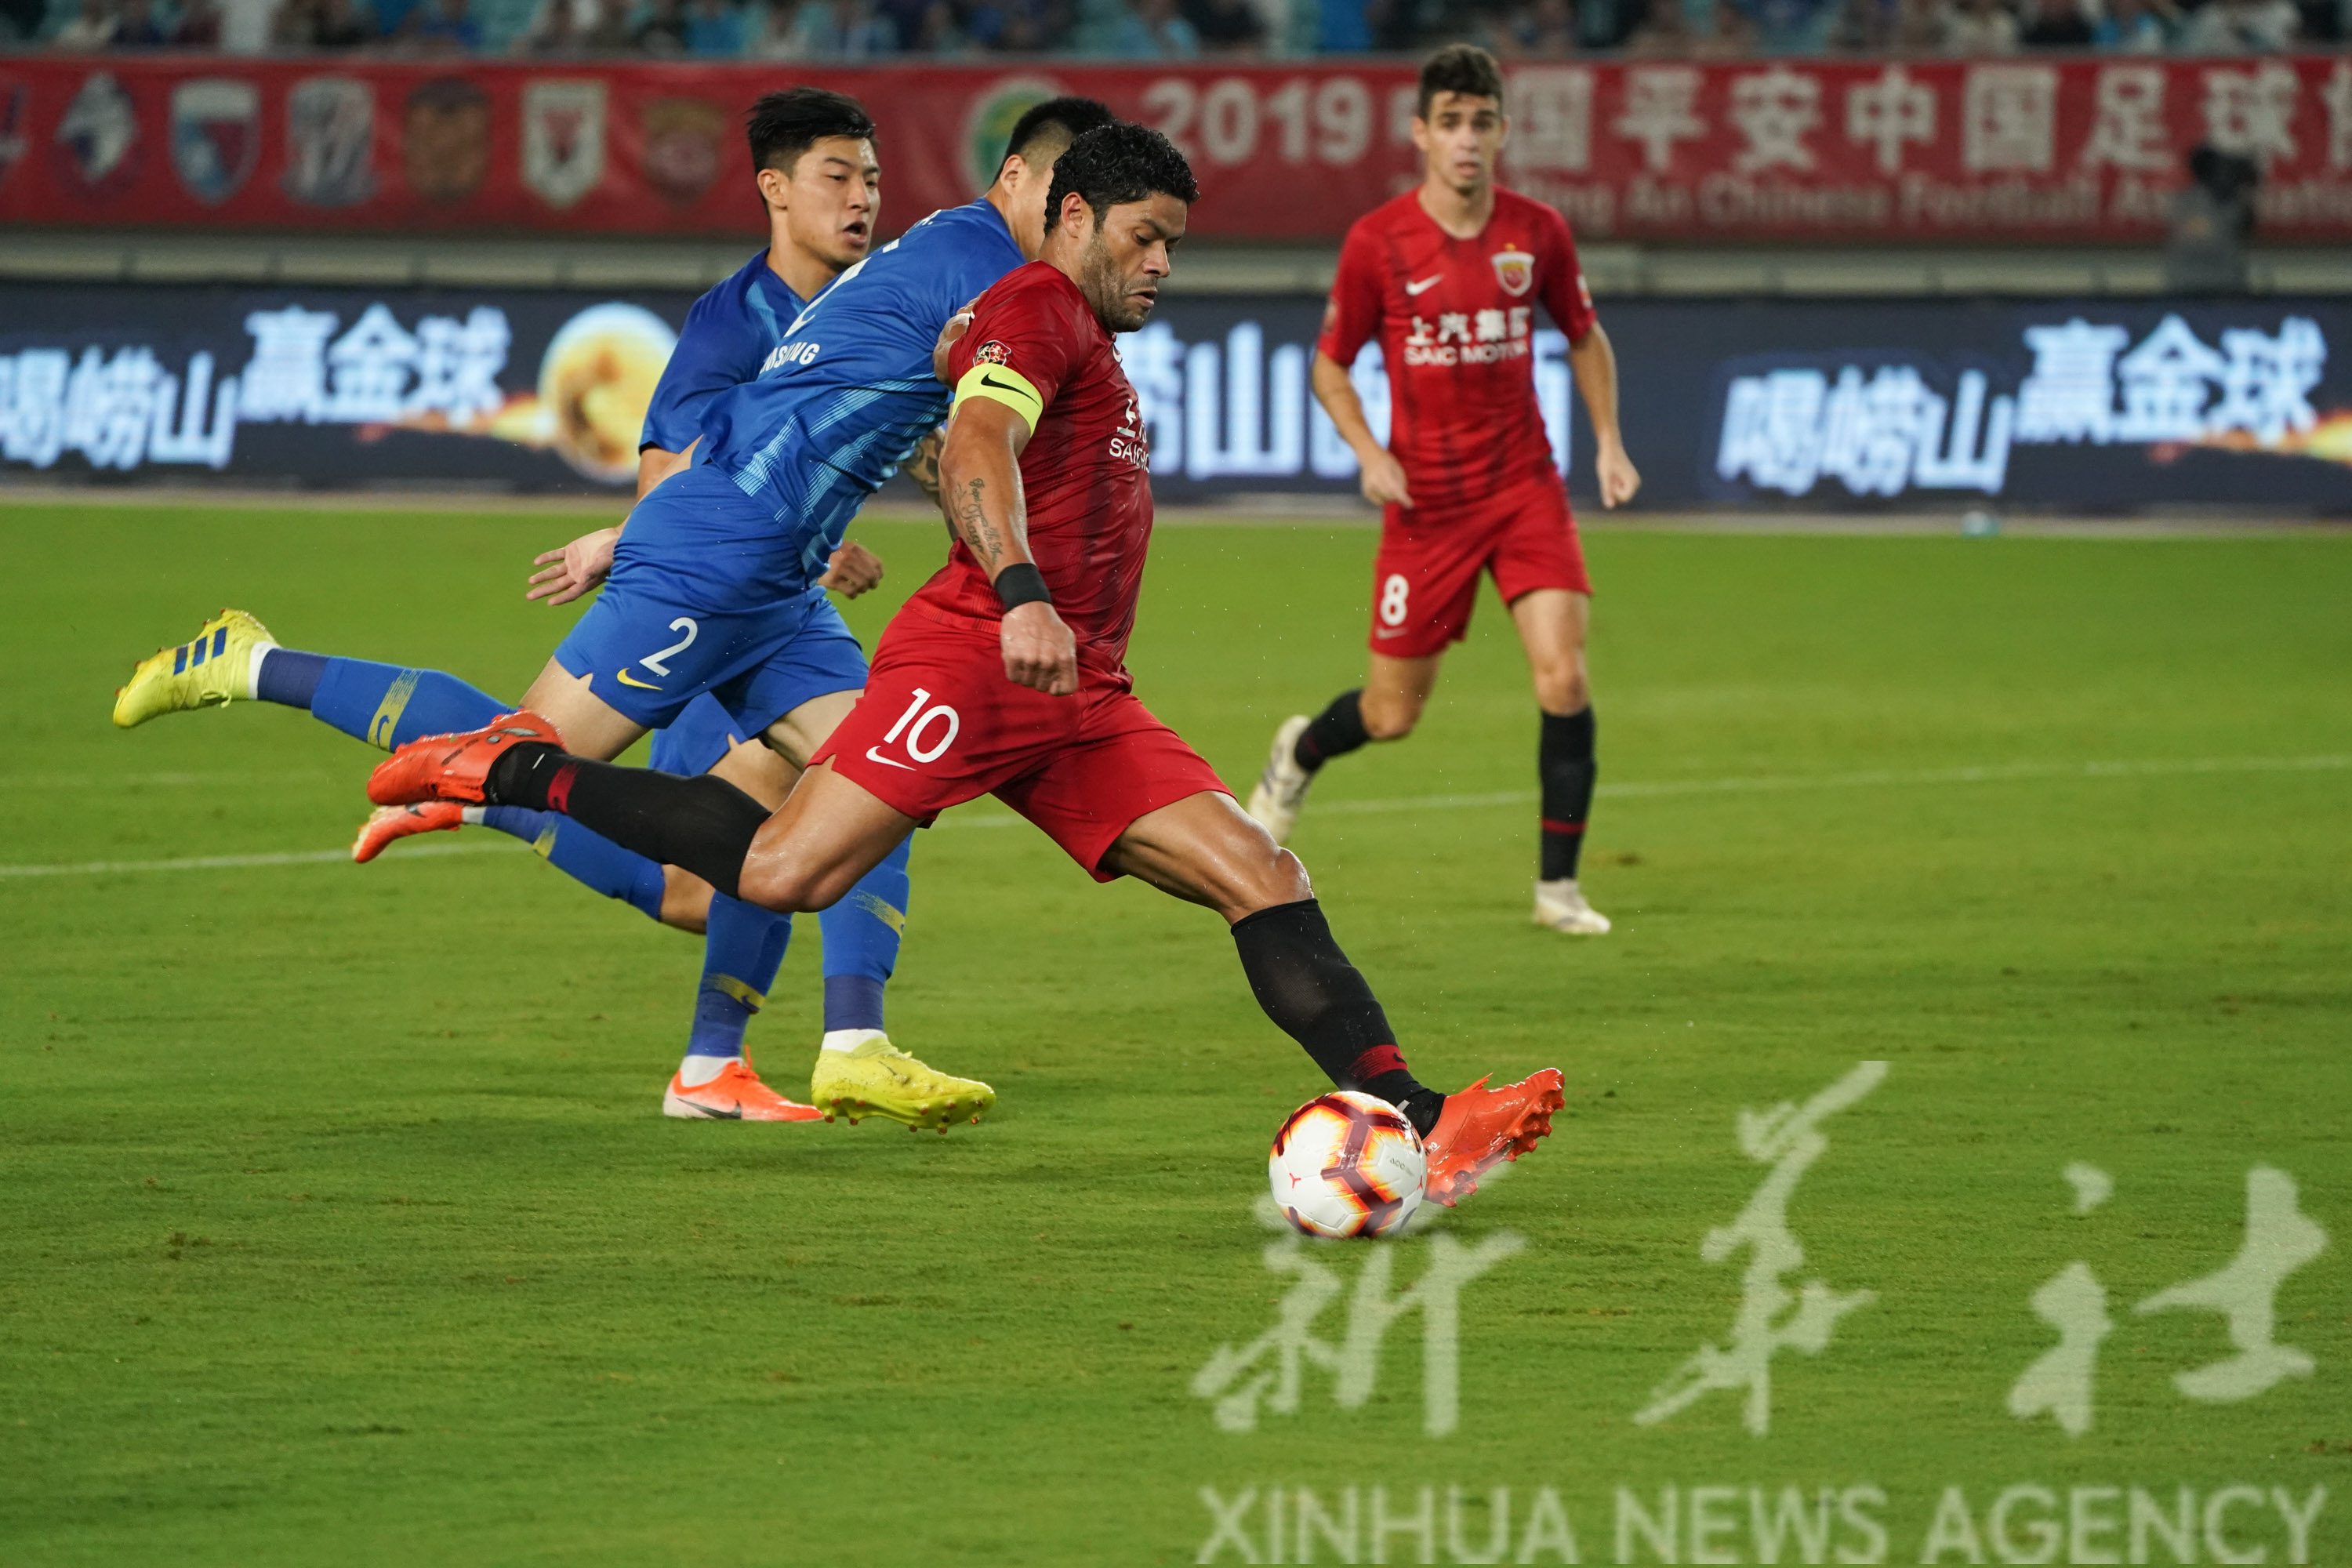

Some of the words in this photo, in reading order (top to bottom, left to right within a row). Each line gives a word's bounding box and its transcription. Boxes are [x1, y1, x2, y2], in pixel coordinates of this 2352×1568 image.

[1381, 573, 1410, 626] 8
[639, 616, 698, 677] 2
[883, 688, 960, 763] 10
